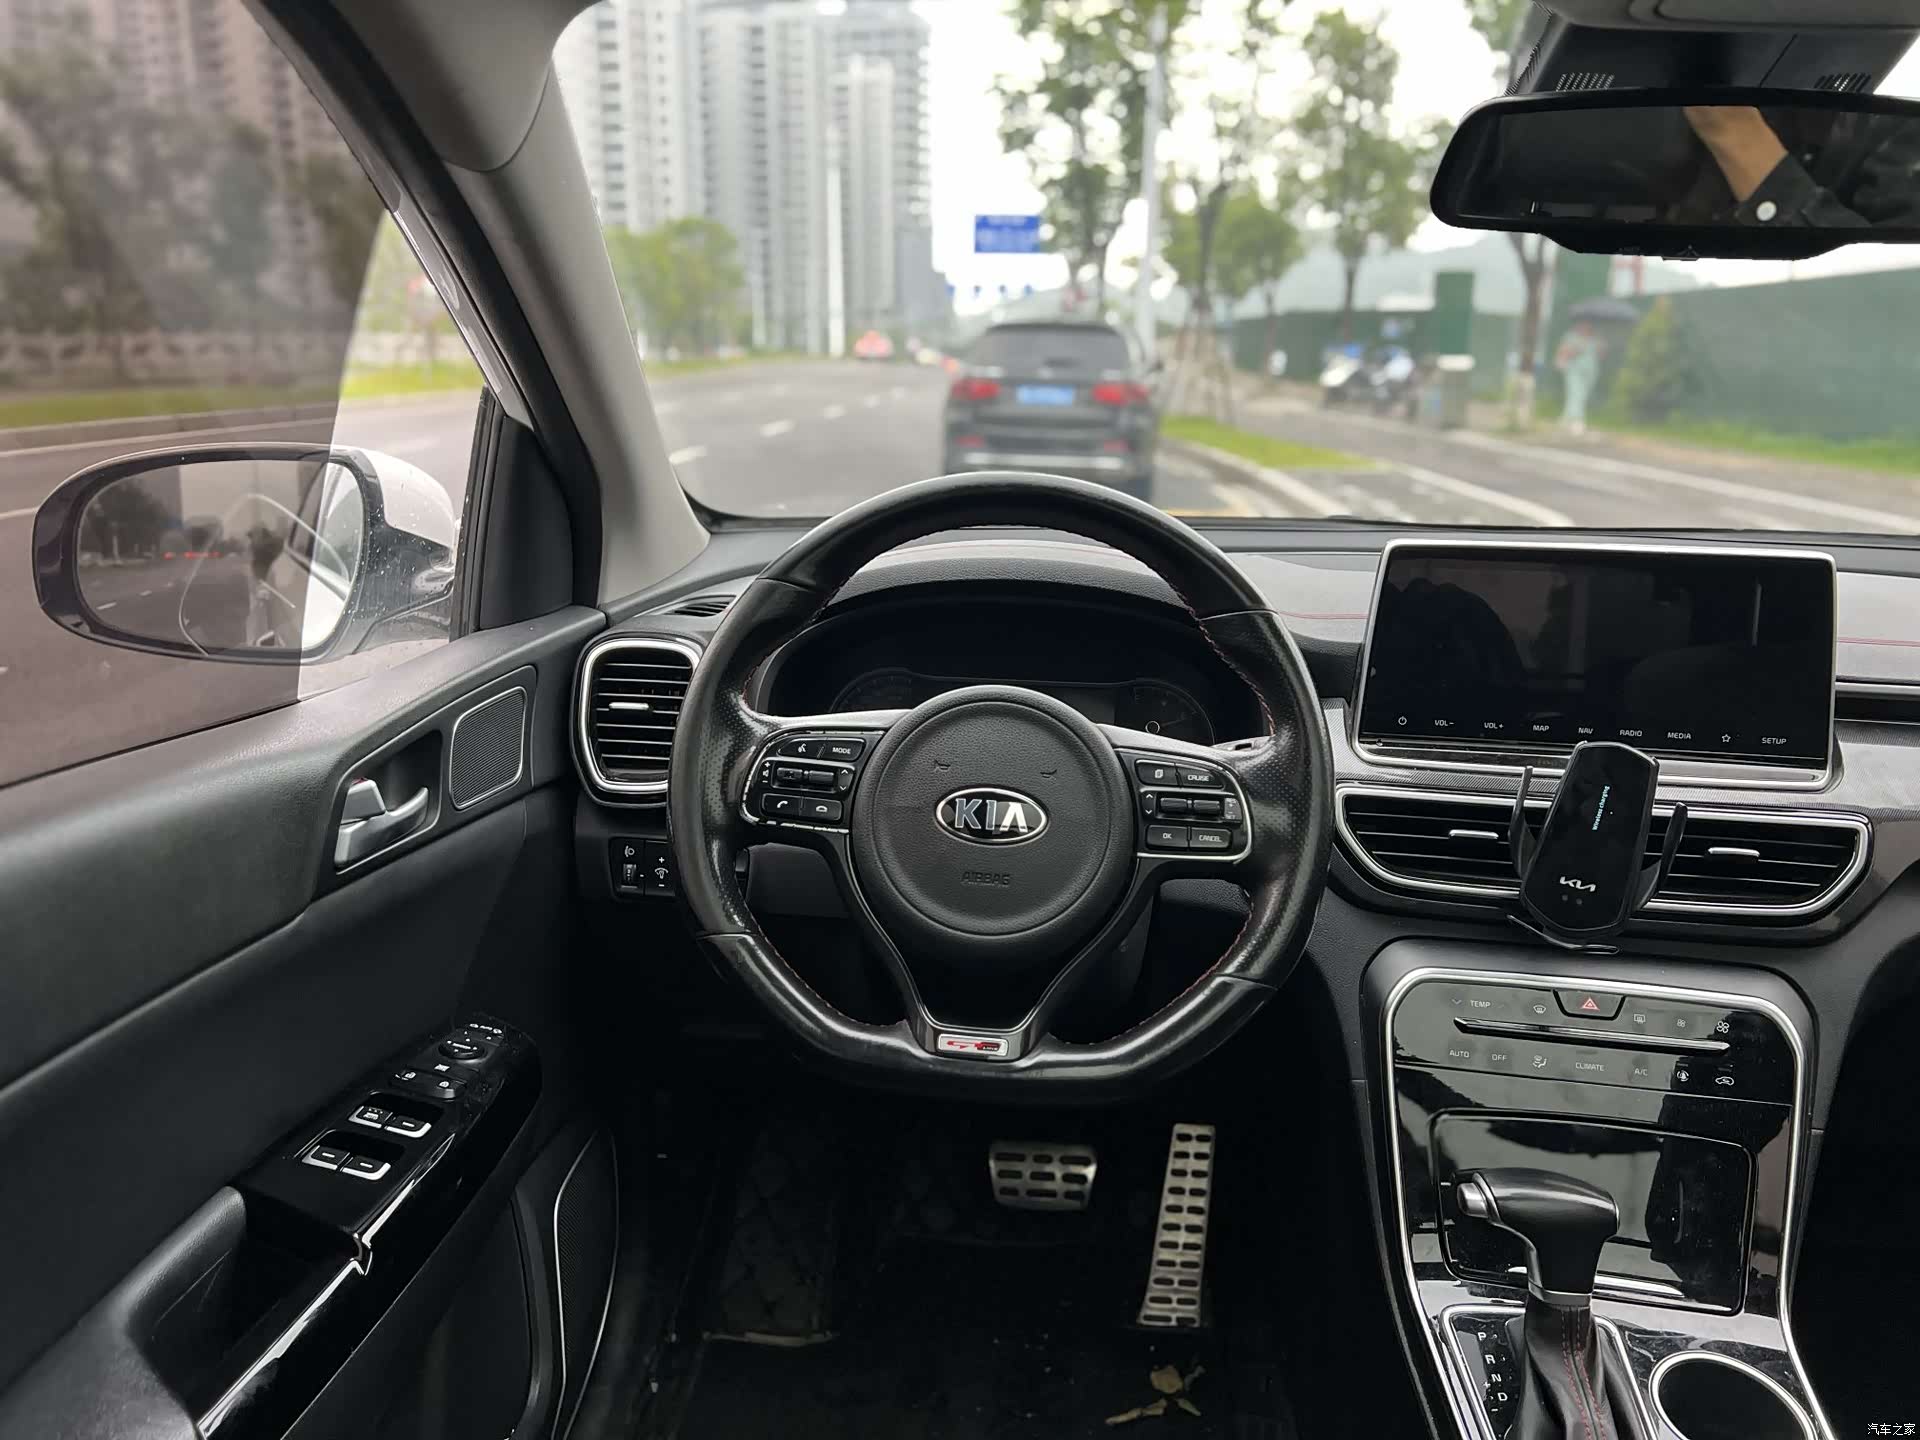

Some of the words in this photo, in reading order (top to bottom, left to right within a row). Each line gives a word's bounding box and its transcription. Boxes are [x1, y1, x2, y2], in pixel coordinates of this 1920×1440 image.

[1533, 724, 1549, 732] MAP
[1578, 726, 1594, 735] NAV
[1619, 729, 1643, 737] RADIO
[1667, 731, 1692, 740] MEDIA
[1761, 737, 1787, 745] SETUP
[832, 746, 851, 754] MODE
[1187, 774, 1209, 782] CRUISE
[954, 798, 1029, 833] KIA
[1199, 834, 1223, 843] CANCEL
[1470, 999, 1491, 1008] TEMP
[1449, 1049, 1470, 1058] AUTO
[1491, 1053, 1507, 1061] OFF
[1575, 1062, 1605, 1072] CLIMATE
[1634, 1068, 1648, 1076] A/C
[1477, 1331, 1487, 1341] P
[1484, 1354, 1496, 1365] R
[1491, 1373, 1502, 1382] N
[1497, 1392, 1508, 1401] D
